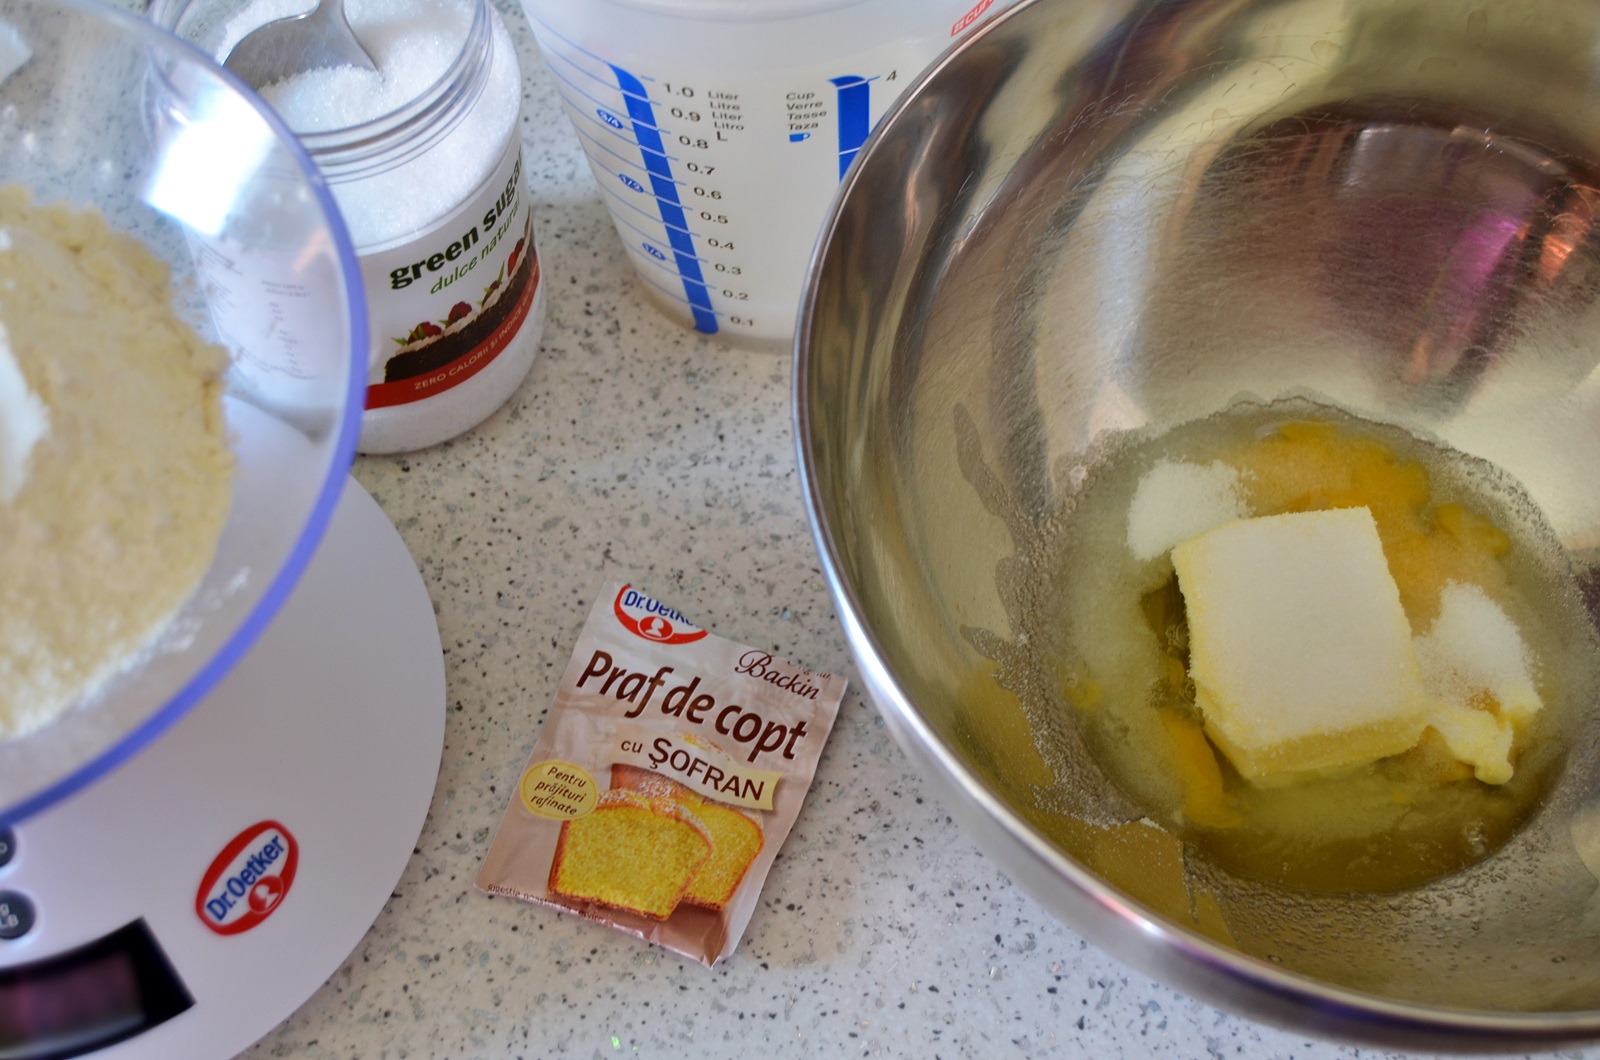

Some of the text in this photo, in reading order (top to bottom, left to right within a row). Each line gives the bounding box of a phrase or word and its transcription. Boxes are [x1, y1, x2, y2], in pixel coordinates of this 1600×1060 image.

[886, 70, 897, 82] 4
[663, 83, 695, 98] 1.0
[708, 90, 739, 101] Liter
[786, 92, 815, 101] Cup
[710, 101, 740, 111] Litre
[786, 101, 823, 111] Verre
[671, 107, 701, 123] 0.9
[712, 111, 743, 121] Liter
[787, 111, 827, 121] Tasse
[714, 121, 744, 131] Litro
[787, 122, 819, 131] Taza
[679, 135, 709, 150] 0.8
[716, 131, 728, 142] L
[686, 162, 715, 175] 0.7
[693, 187, 722, 200] 0.6
[700, 211, 728, 225] 0.5
[430, 190, 520, 295] dulce natural
[707, 237, 735, 250] 0.4
[390, 226, 479, 290] green
[714, 263, 742, 275] 0.3
[722, 289, 749, 301] 0.2
[730, 315, 754, 327] 0.1
[414, 374, 446, 390] ZERO
[449, 347, 489, 376] CALORII
[499, 306, 522, 340] INDICE
[734, 650, 820, 700] Backin
[576, 650, 808, 763] Praf de copt
[620, 740, 643, 755] cu
[547, 766, 587, 788] Pentru
[530, 795, 577, 815] rafinate
